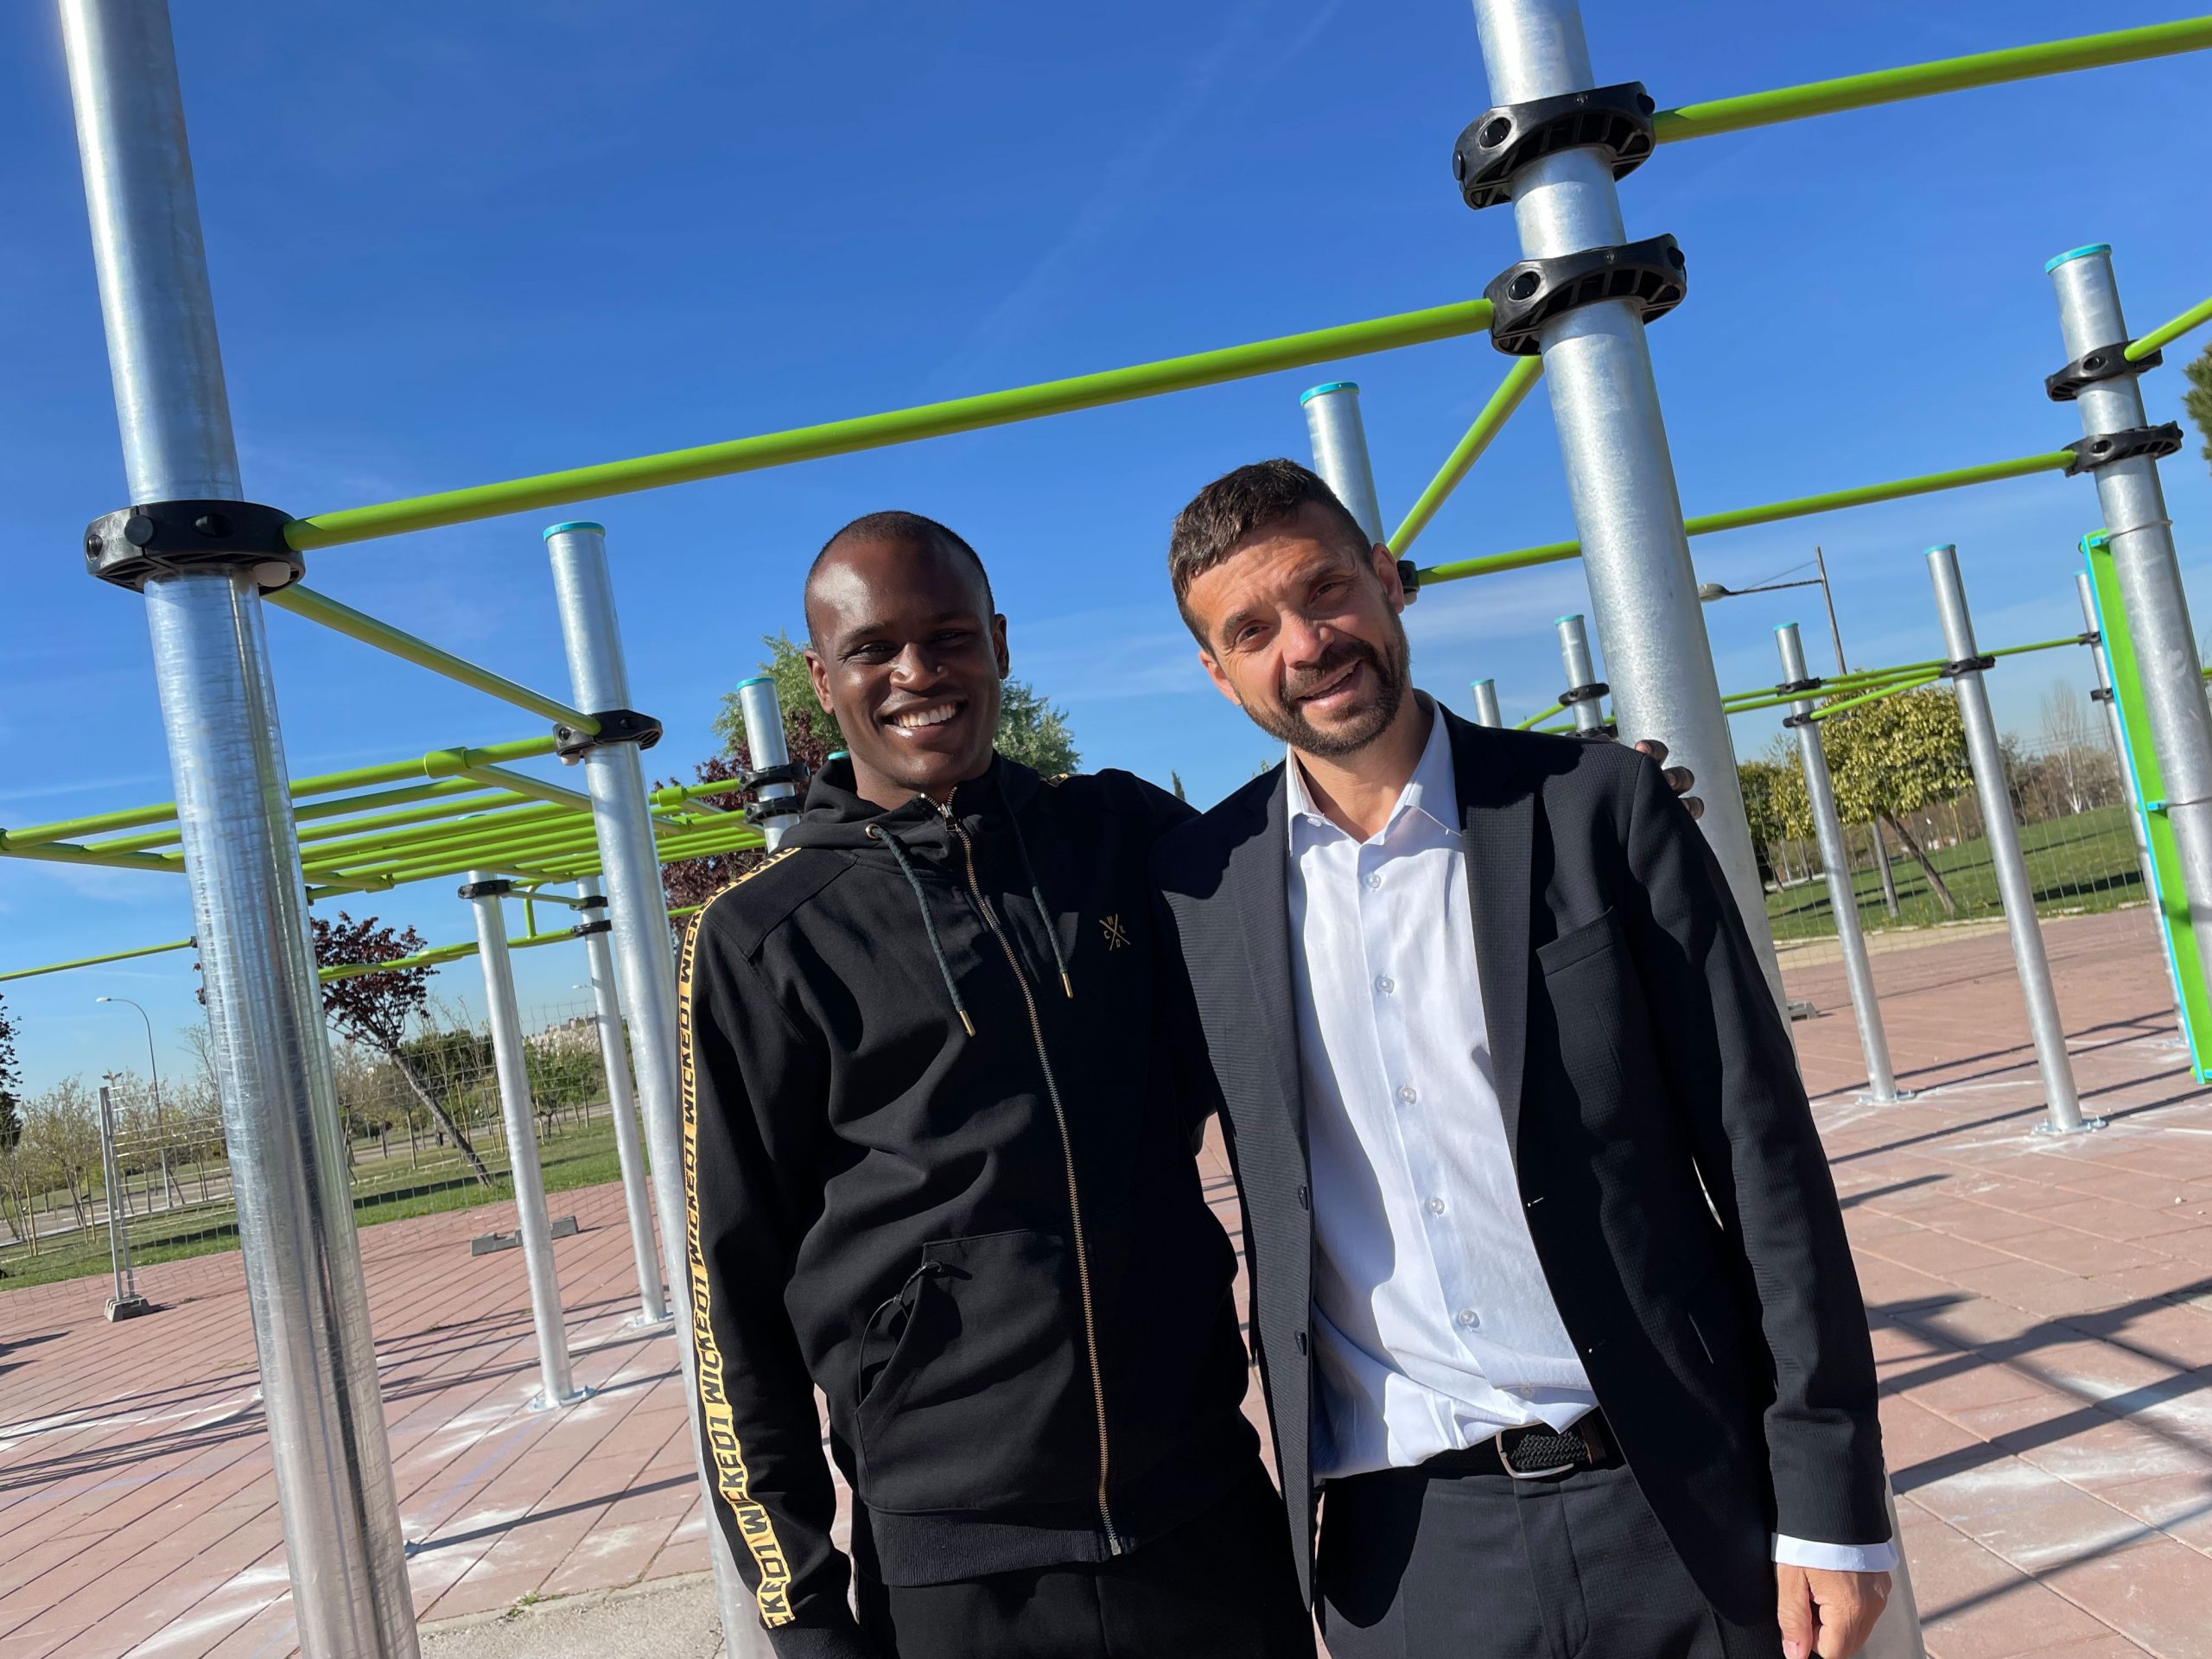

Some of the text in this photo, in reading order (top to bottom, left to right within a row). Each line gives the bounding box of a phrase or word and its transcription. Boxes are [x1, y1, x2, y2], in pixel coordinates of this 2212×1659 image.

[680, 995, 695, 1126] WICKED1
[684, 1135, 704, 1268] WICKED1
[694, 1275, 726, 1405] WICKED1
